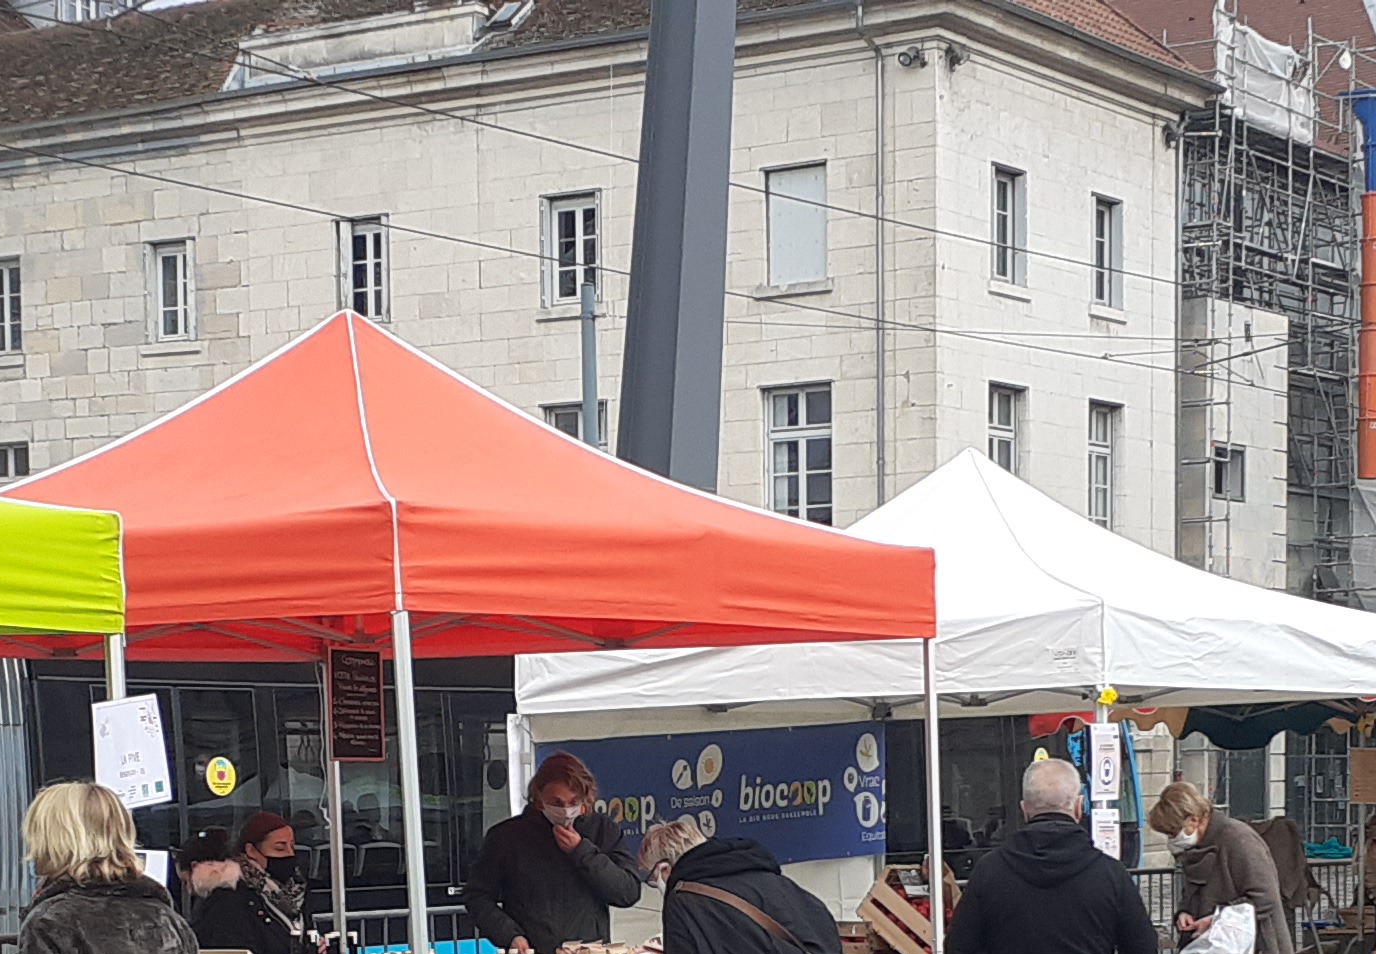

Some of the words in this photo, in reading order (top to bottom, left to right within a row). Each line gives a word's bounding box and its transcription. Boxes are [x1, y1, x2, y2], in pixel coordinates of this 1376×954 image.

[858, 775, 880, 788] Vrac
[739, 773, 832, 816] biocoop
[670, 796, 682, 808] De
[684, 795, 710, 808] saison
